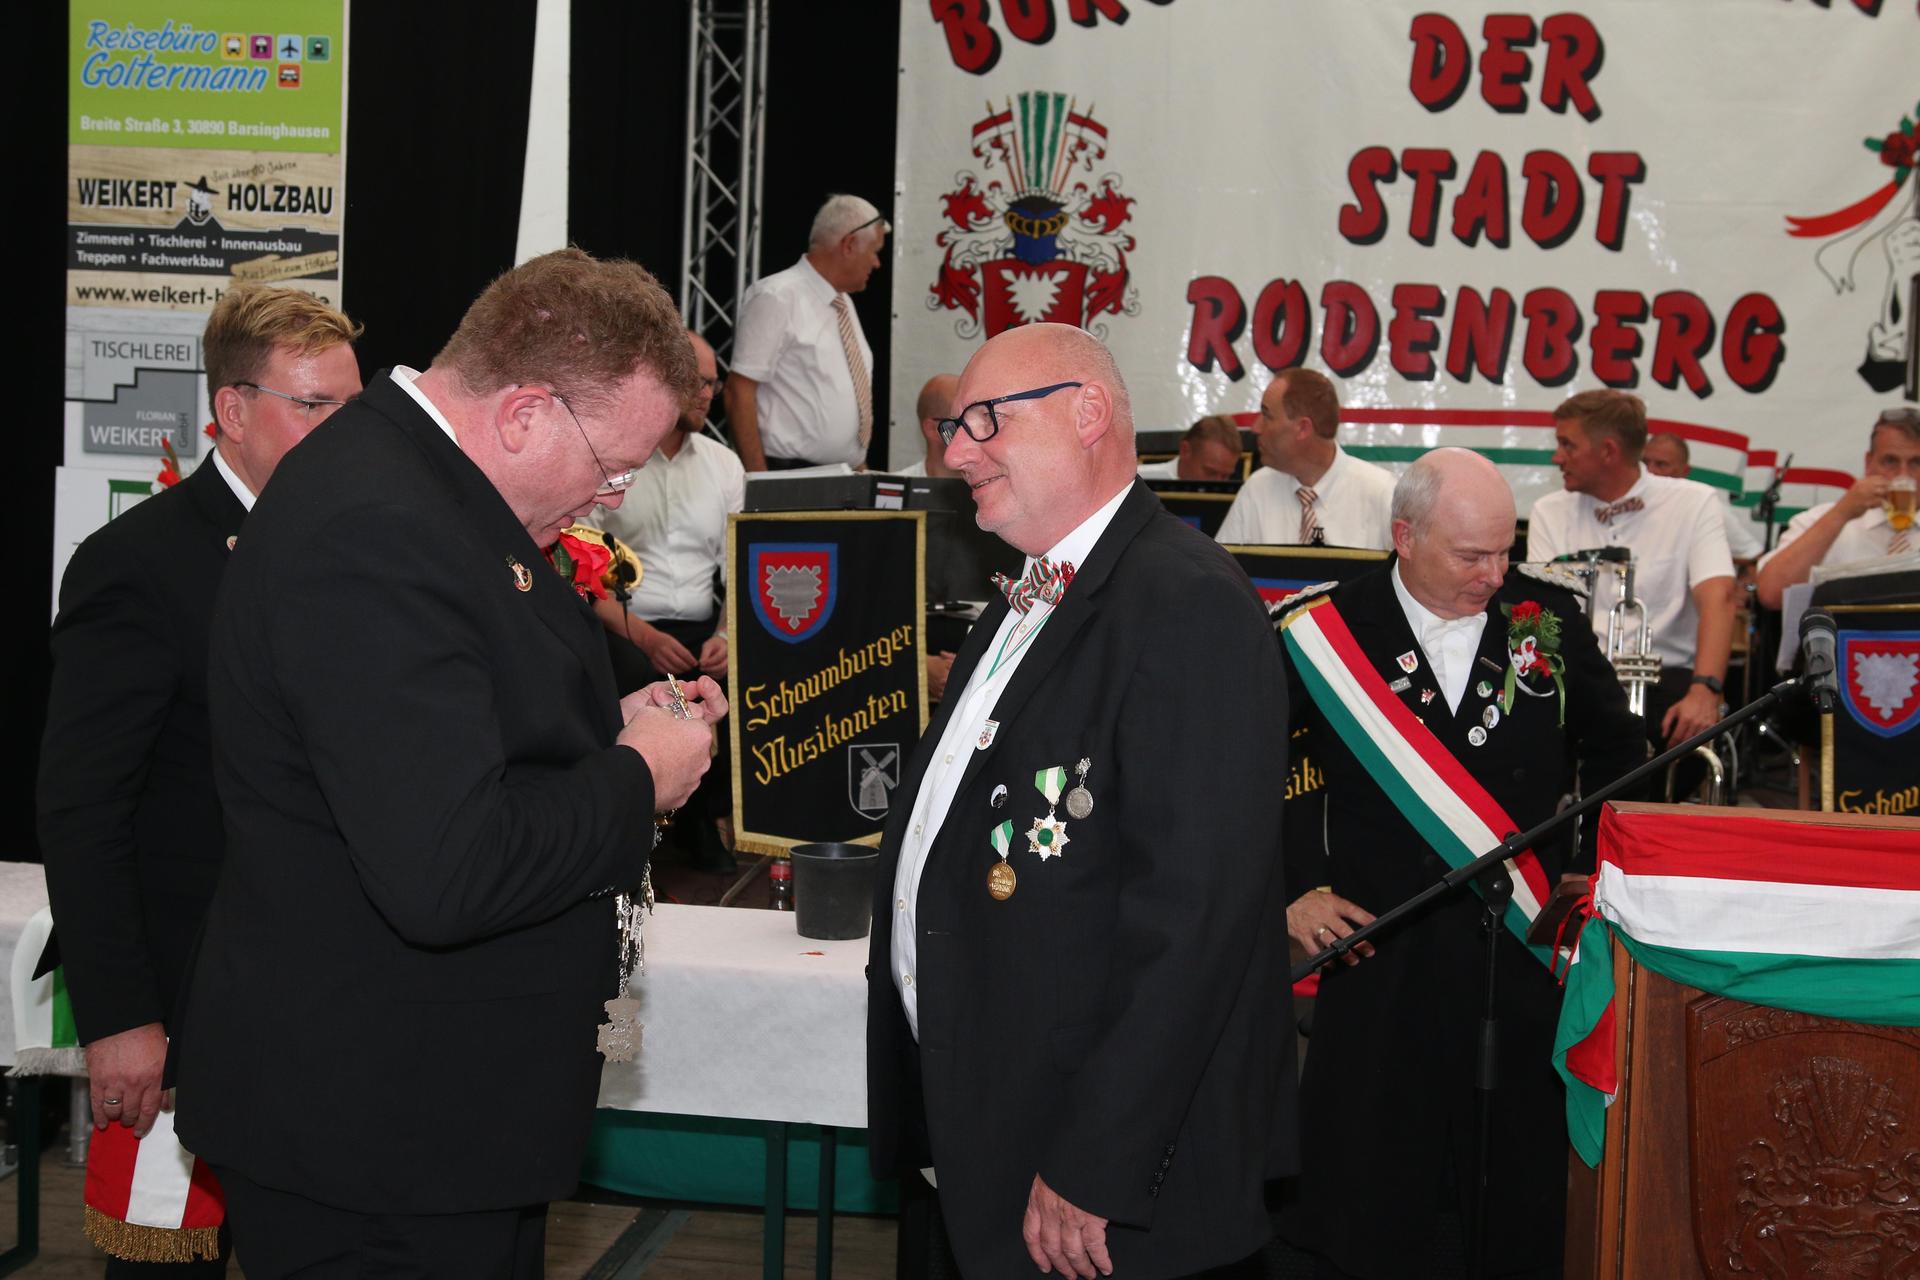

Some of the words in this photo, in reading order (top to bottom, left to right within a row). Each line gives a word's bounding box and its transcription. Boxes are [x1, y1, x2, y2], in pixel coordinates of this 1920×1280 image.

[87, 20, 217, 51] Reisebüro
[81, 52, 268, 92] Goltermann
[1409, 12, 1605, 123] DER
[80, 116, 121, 132] Breite
[125, 117, 168, 134] Straße
[172, 119, 185, 136] 3,
[187, 119, 224, 135] 30890
[228, 121, 330, 140] Barsinghausen
[77, 177, 177, 209] WEIKERT
[227, 183, 333, 215] HOLZBAU
[1338, 145, 1646, 252] STADT
[76, 231, 134, 246] Zimmerei
[148, 233, 207, 248] Tischlerei
[221, 237, 302, 252] Innenausbau
[76, 251, 126, 266] Treppen
[141, 252, 224, 268] Fachwerkbau
[92, 340, 191, 362] TISCHLEREI
[1186, 274, 1786, 400] RODENBERG
[136, 410, 176, 422] FLORIAN
[90, 425, 174, 447] WEIKERT
[745, 624, 913, 731] Schaumburger
[752, 689, 908, 786] Musikanten
